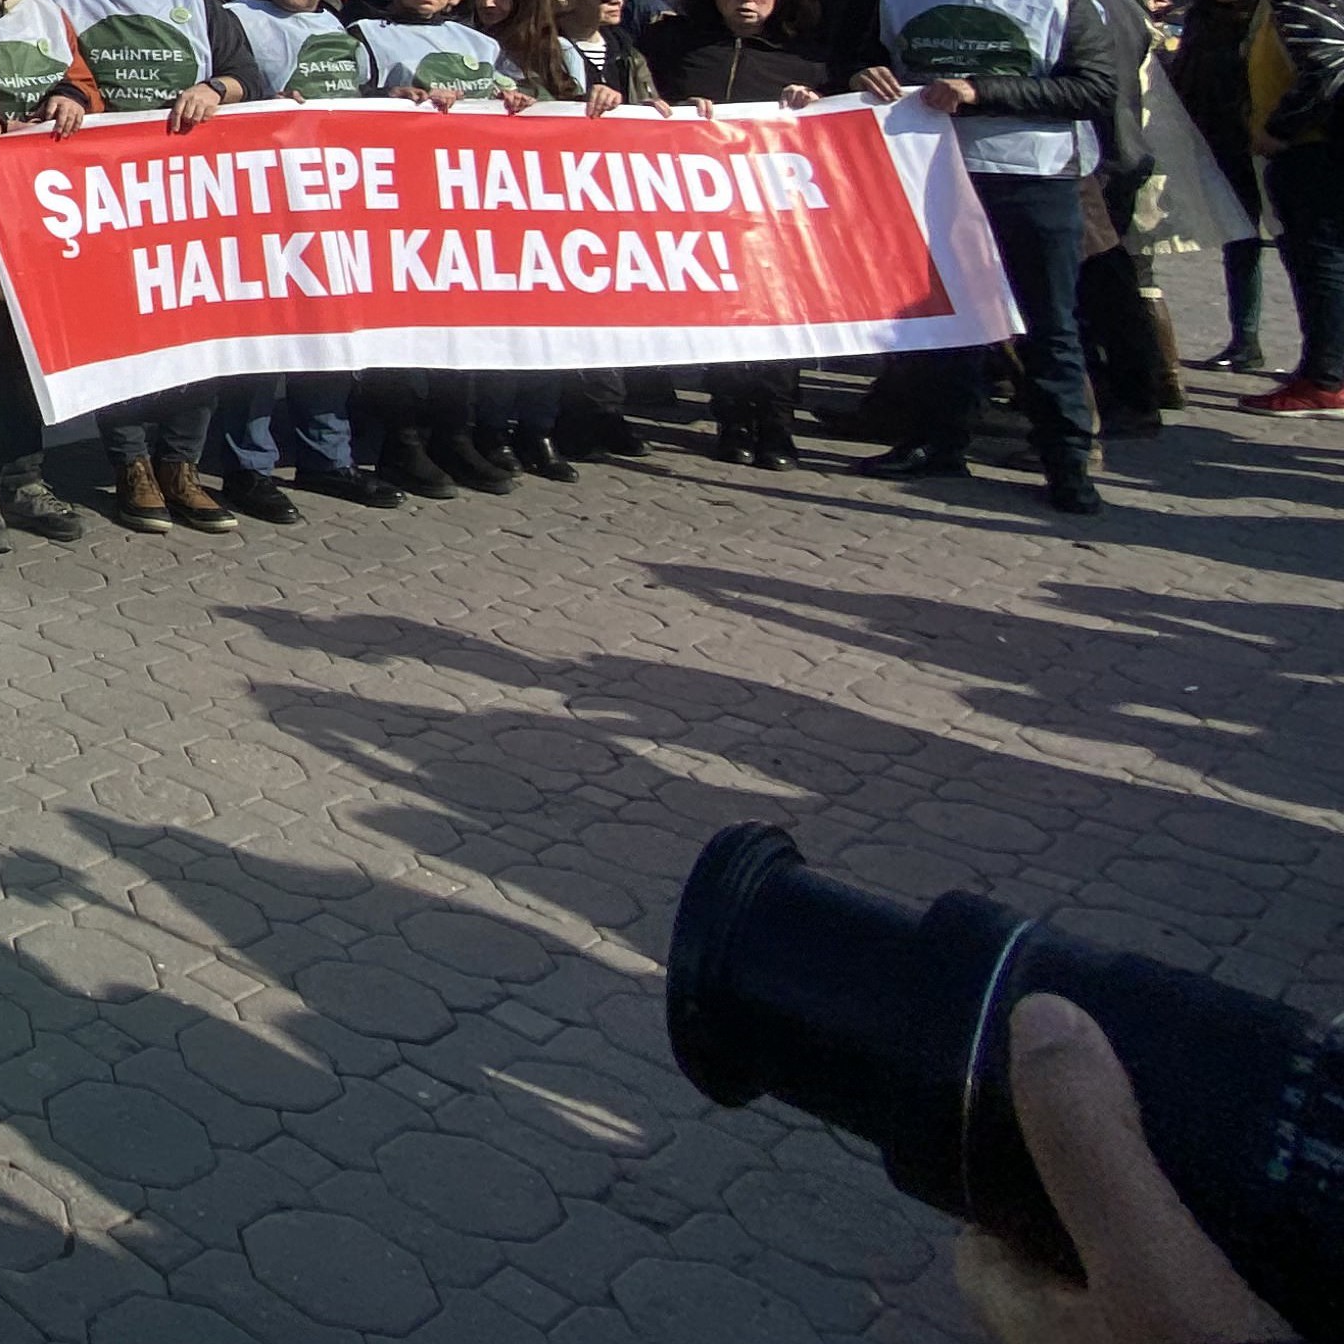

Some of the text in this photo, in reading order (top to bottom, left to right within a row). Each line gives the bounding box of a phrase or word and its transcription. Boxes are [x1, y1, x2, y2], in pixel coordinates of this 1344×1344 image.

[90, 47, 184, 64] ŞAHİNTEPE
[115, 68, 161, 81] HALK
[34, 147, 829, 258] ŞAHİNTEPE HALKINDIR
[132, 228, 739, 315] HALKIN KALACAK!
